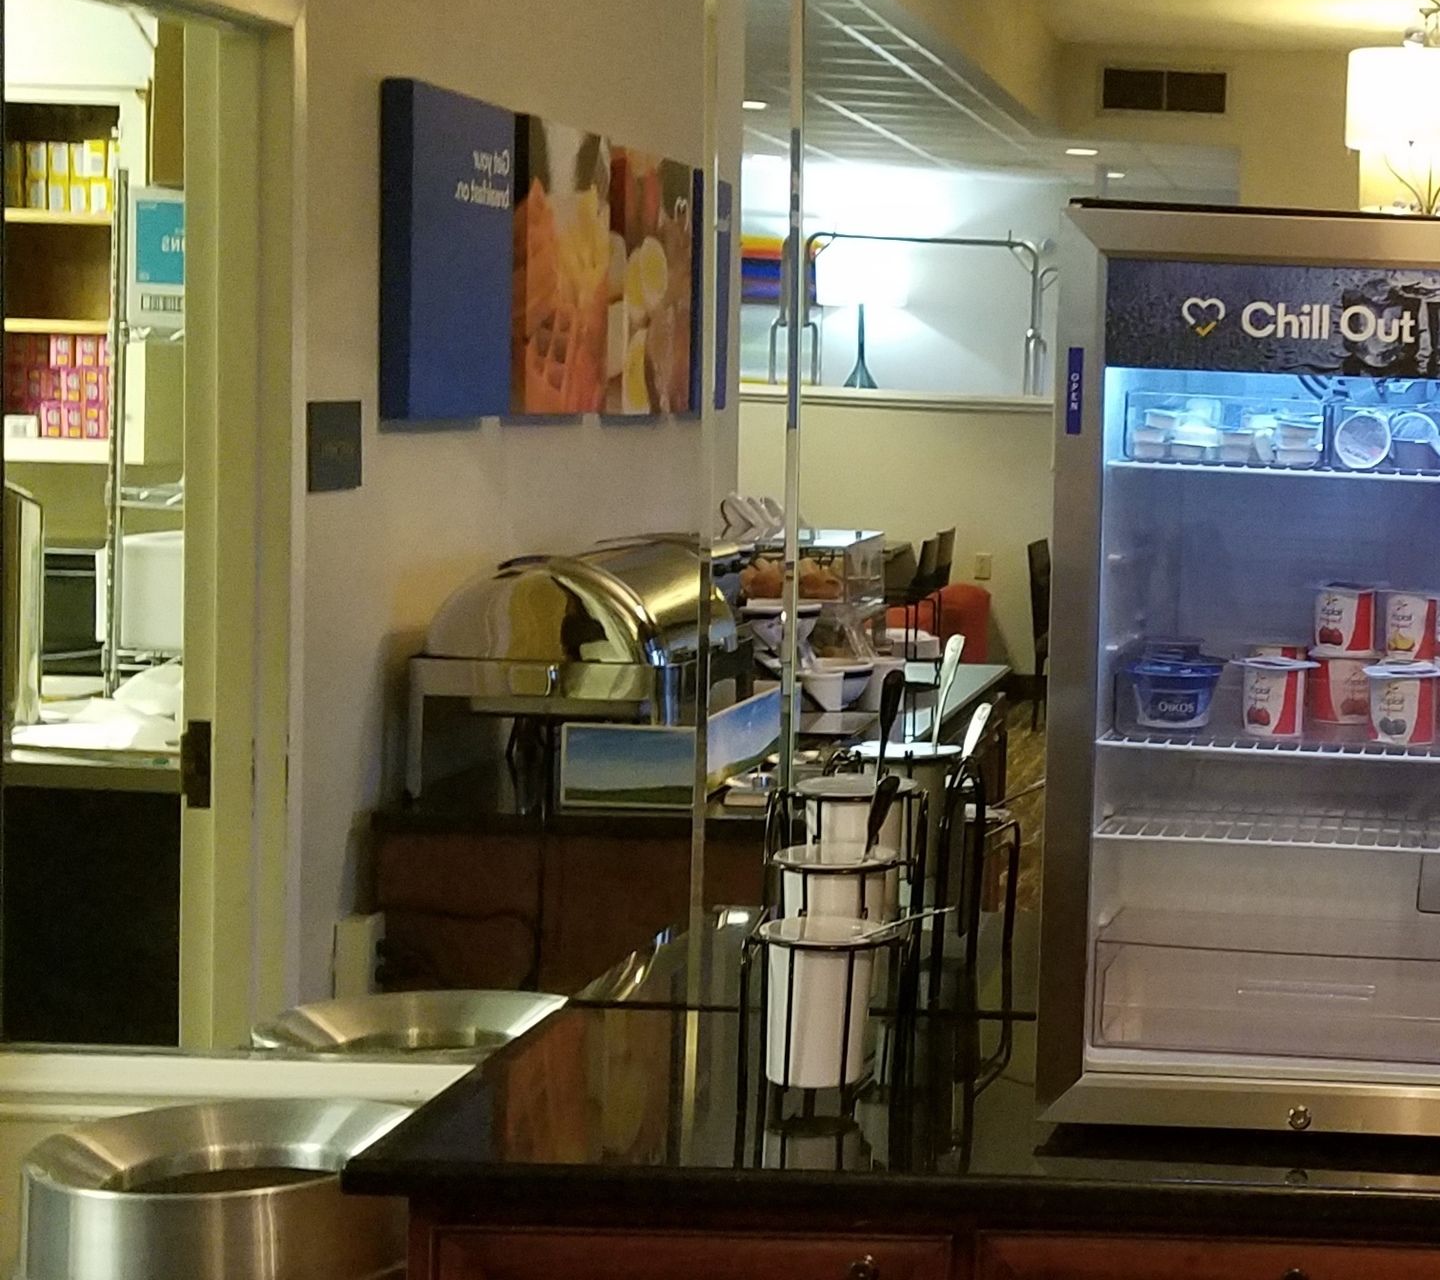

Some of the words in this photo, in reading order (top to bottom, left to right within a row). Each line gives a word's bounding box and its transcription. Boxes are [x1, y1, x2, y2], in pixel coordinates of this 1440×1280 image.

[1240, 300, 1329, 339] Chill
[1339, 304, 1416, 344] Out
[1070, 372, 1080, 410] OPEN
